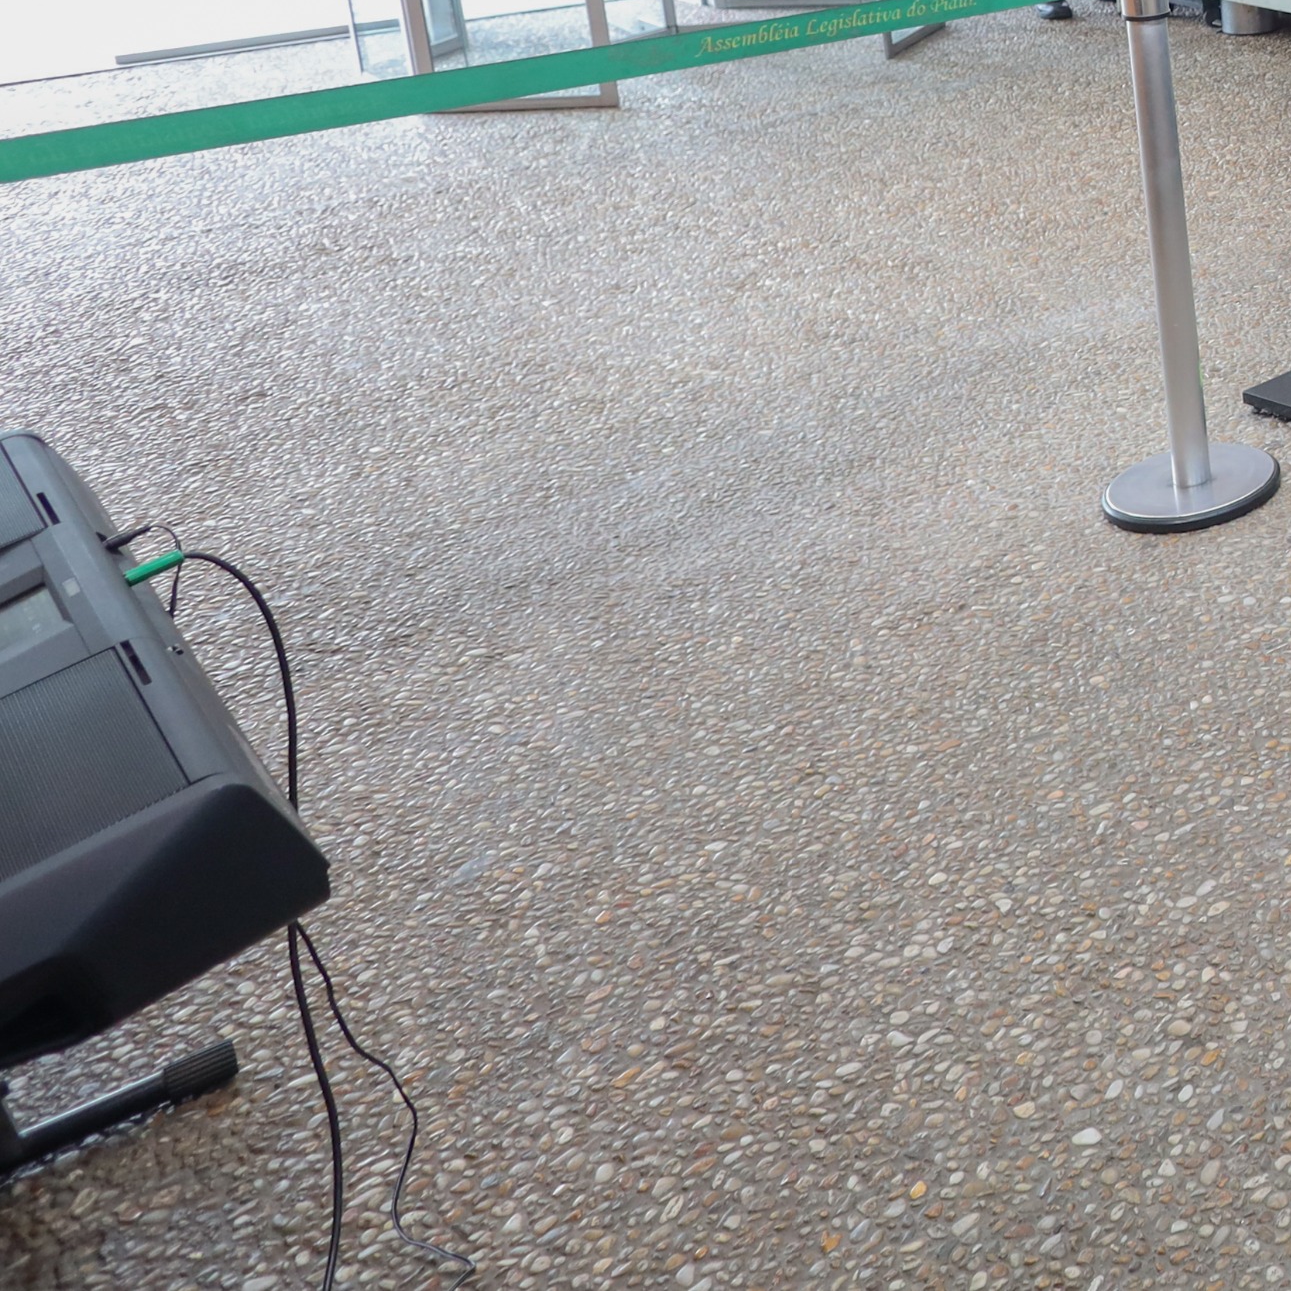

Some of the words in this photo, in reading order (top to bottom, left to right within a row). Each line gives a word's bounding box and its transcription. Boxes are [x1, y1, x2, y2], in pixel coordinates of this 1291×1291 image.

[694, 23, 800, 58] Assembléia
[805, 6, 902, 39] Legislativa
[906, 2, 927, 20] do
